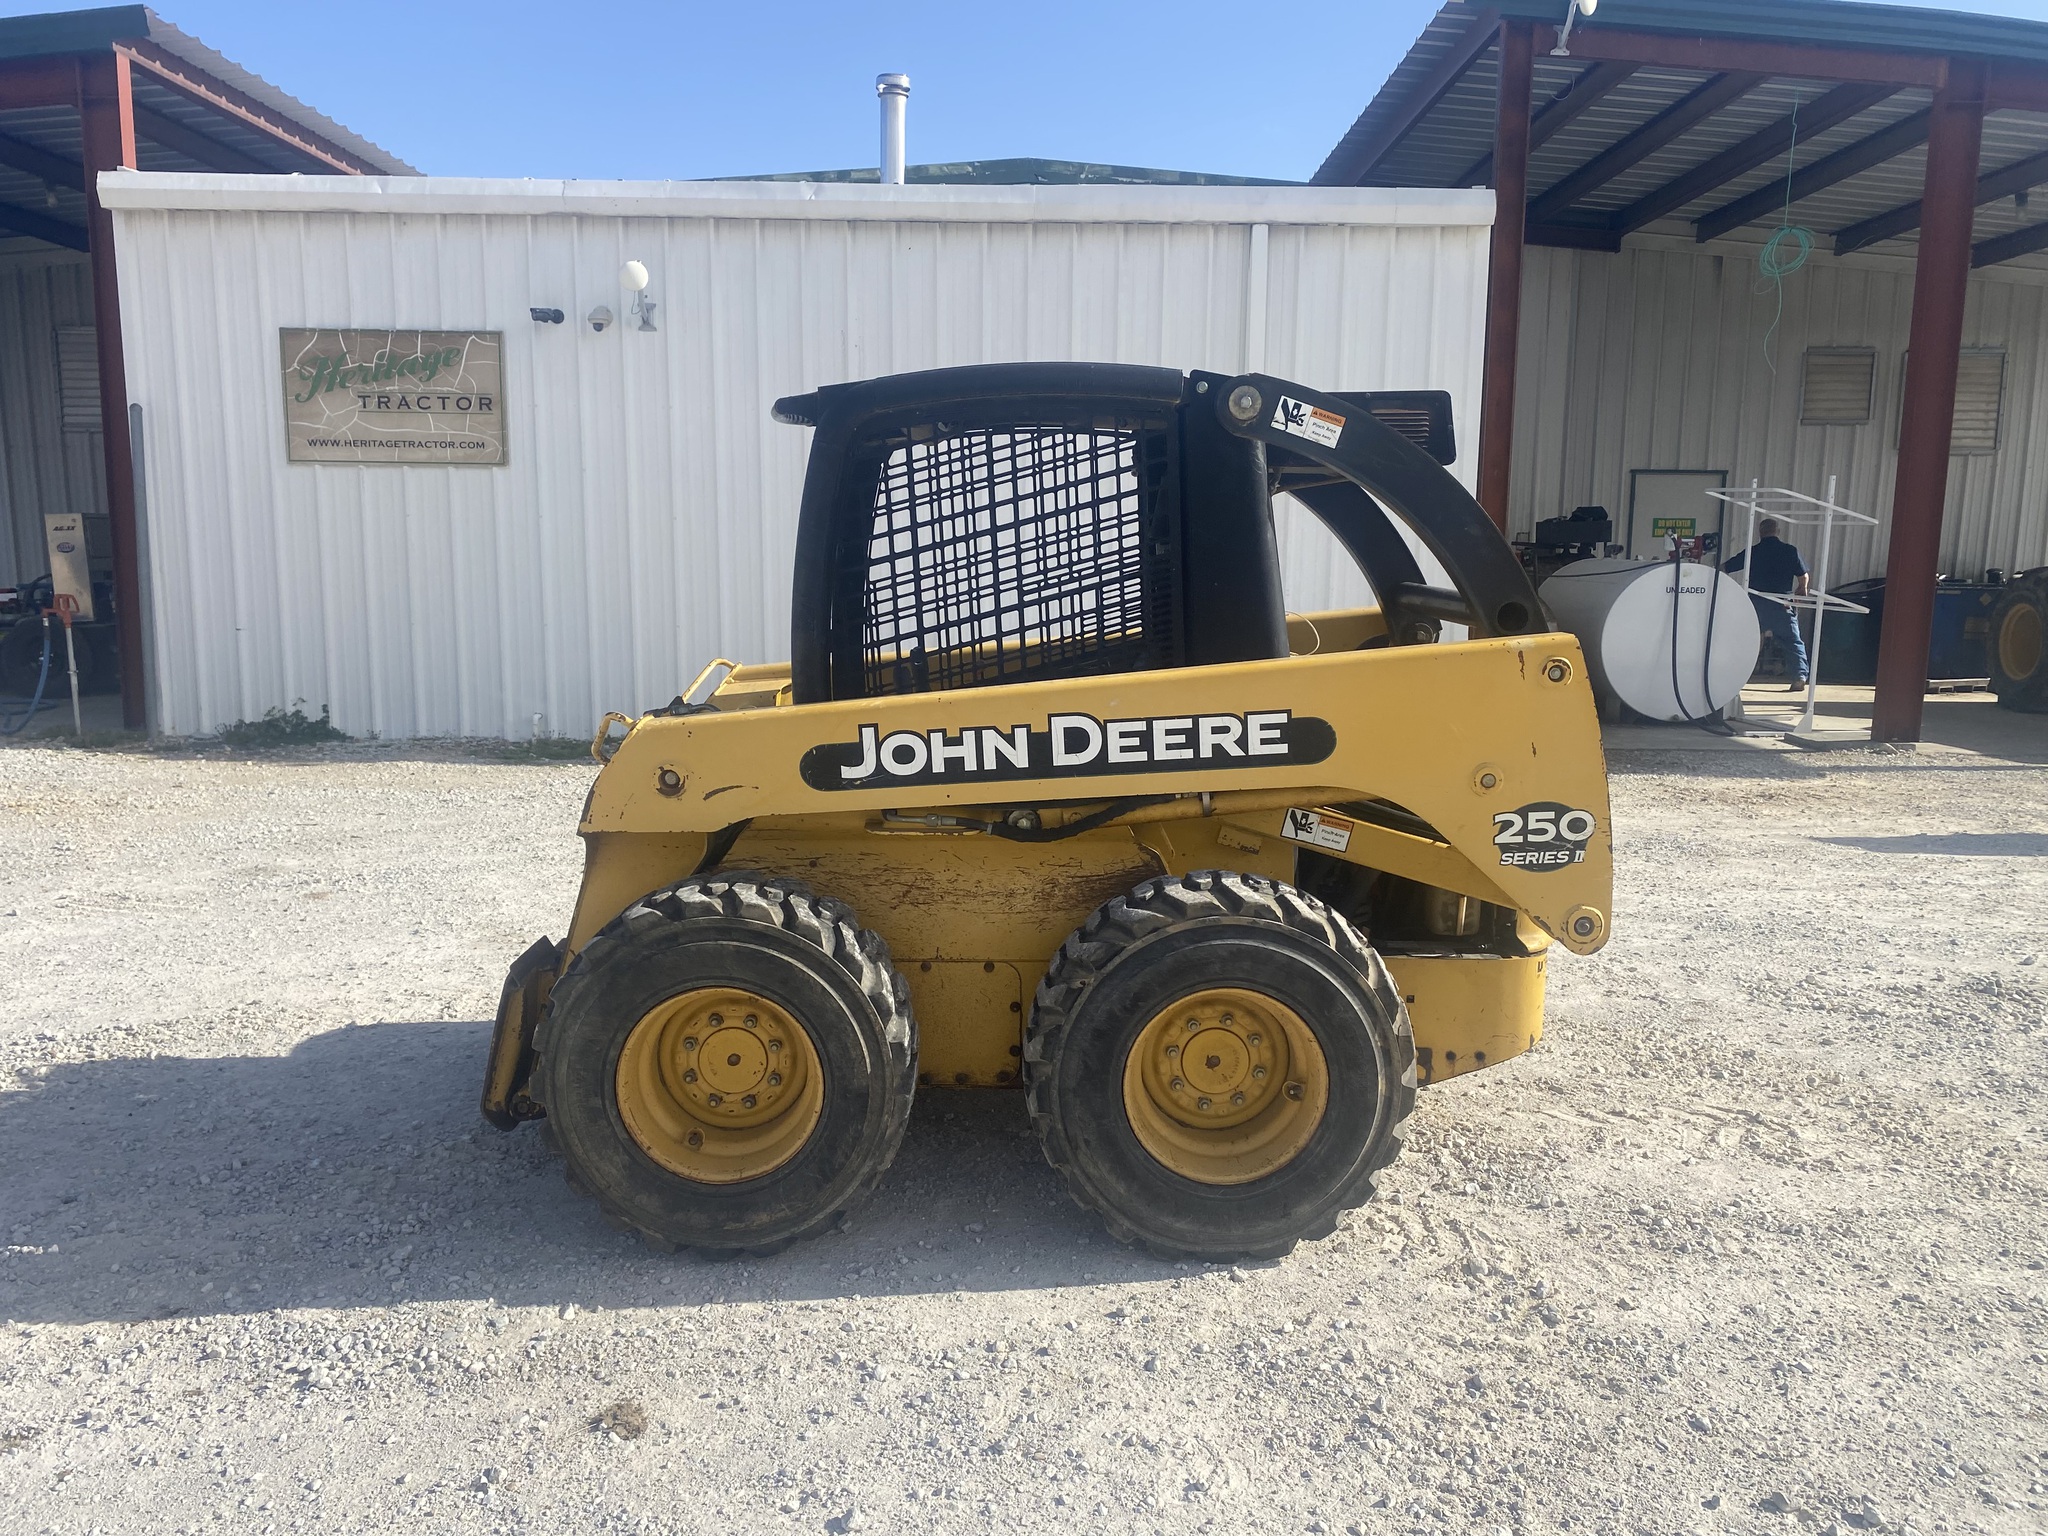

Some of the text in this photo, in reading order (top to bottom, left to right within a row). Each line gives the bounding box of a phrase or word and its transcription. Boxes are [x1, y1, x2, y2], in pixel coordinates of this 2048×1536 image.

[294, 347, 461, 403] Heritage
[358, 395, 493, 411] TRACTOR
[1318, 411, 1342, 424] WARNING
[307, 438, 485, 450] WWW.HERITAGETRACTOR.COM
[1665, 586, 1706, 594] UNEADED
[841, 713, 1290, 779] JOHN DEERE
[1494, 810, 1595, 844] 250
[1501, 850, 1570, 866] SERIES
